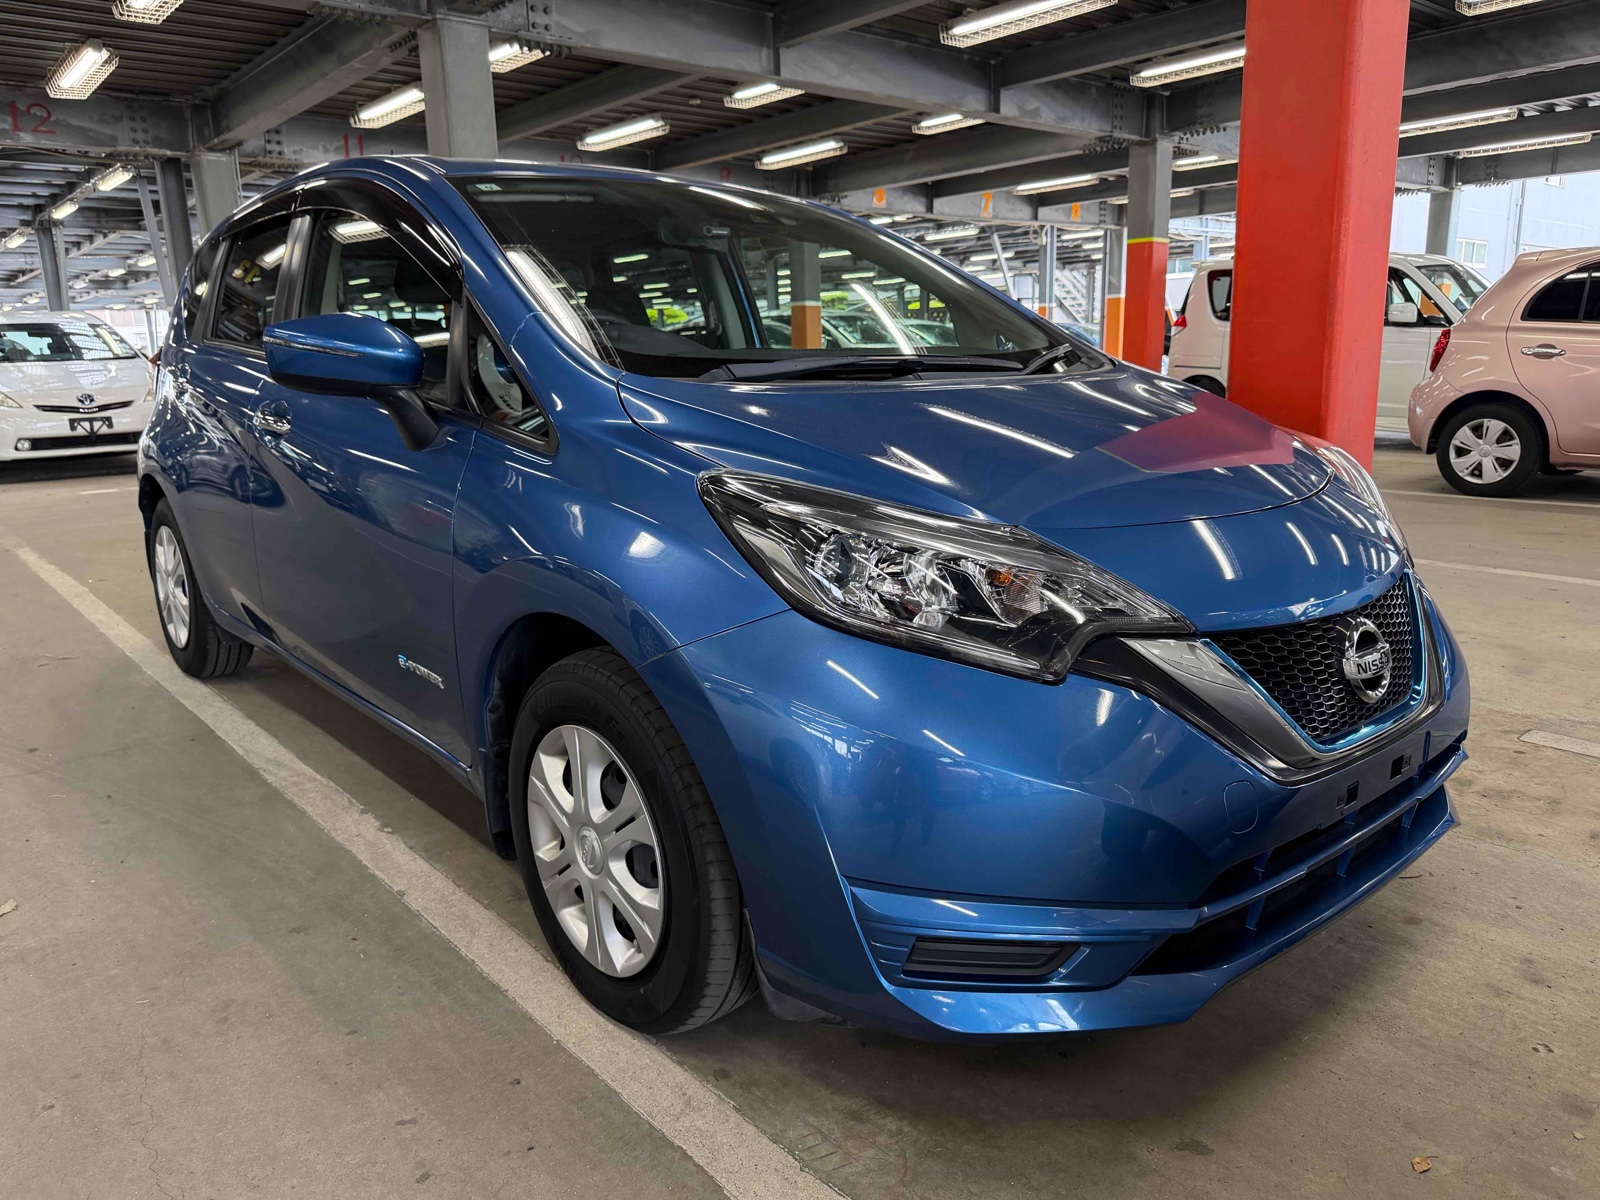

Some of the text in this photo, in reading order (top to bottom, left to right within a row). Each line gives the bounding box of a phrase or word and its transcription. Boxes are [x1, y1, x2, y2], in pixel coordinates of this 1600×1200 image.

[10, 100, 57, 135] 12
[343, 132, 364, 159] 11
[982, 191, 993, 215] 7
